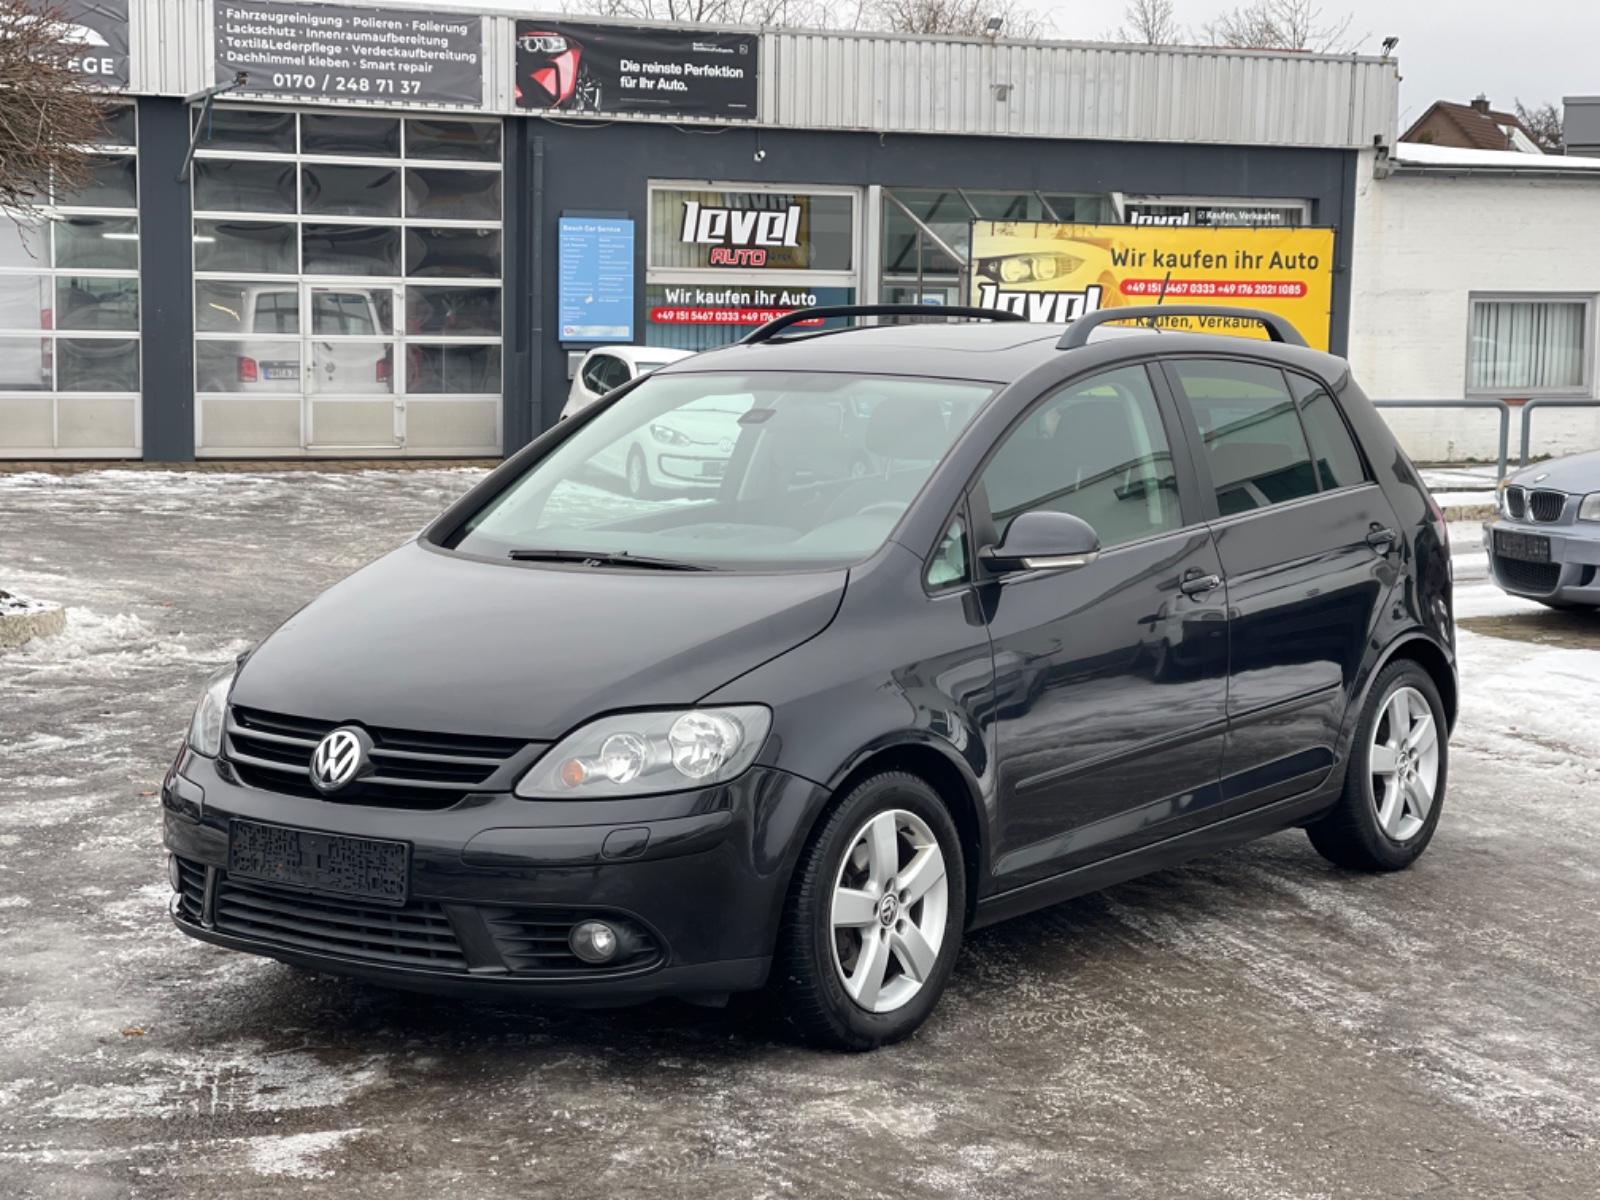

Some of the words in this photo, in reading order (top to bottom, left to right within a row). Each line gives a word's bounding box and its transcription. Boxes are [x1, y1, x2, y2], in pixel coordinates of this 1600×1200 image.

[226, 8, 343, 27] Fahrzeugreinigung
[353, 16, 403, 30] Polieren
[412, 20, 468, 36] Folierung
[226, 22, 297, 37] Lackschutz
[306, 27, 449, 48] Innenraumaufbereitung
[226, 36, 342, 55] Textil&Lederpflege
[352, 44, 477, 64] Verdeckaufbereitung
[226, 50, 306, 66] Dachhimmel
[308, 55, 350, 68] kleben
[360, 58, 397, 71] Smart
[398, 61, 434, 74] repair
[620, 59, 641, 73] Die
[642, 61, 683, 75] reinste
[684, 62, 744, 79] Perfektion
[273, 72, 316, 89] 0170
[336, 76, 370, 92] 248
[376, 78, 394, 93] 71
[400, 79, 422, 95] 37
[620, 75, 637, 89] für
[639, 76, 656, 90] Ihr
[657, 77, 688, 92] Auto.
[682, 201, 801, 247] level
[710, 248, 767, 266] AUTO
[1111, 247, 1147, 268] Wir
[1153, 248, 1228, 269] kaufen
[1235, 249, 1264, 270] ihr
[1269, 250, 1320, 270] Auto
[665, 288, 692, 305] Wir
[696, 289, 750, 305] kaufen
[755, 290, 776, 306] ihr
[779, 290, 817, 306] Auto
[1126, 283, 1145, 293] +49
[1147, 283, 1161, 293] 151
[1190, 284, 1216, 295] 0333
[1217, 284, 1236, 294] +49
[1237, 284, 1254, 295] 176
[1254, 284, 1277, 295] 2021
[1278, 285, 1302, 295] 1085
[656, 310, 675, 321] +49
[676, 310, 690, 321] 151
[691, 310, 714, 322] 5467
[715, 311, 740, 322] 0333
[741, 312, 759, 322] +49
